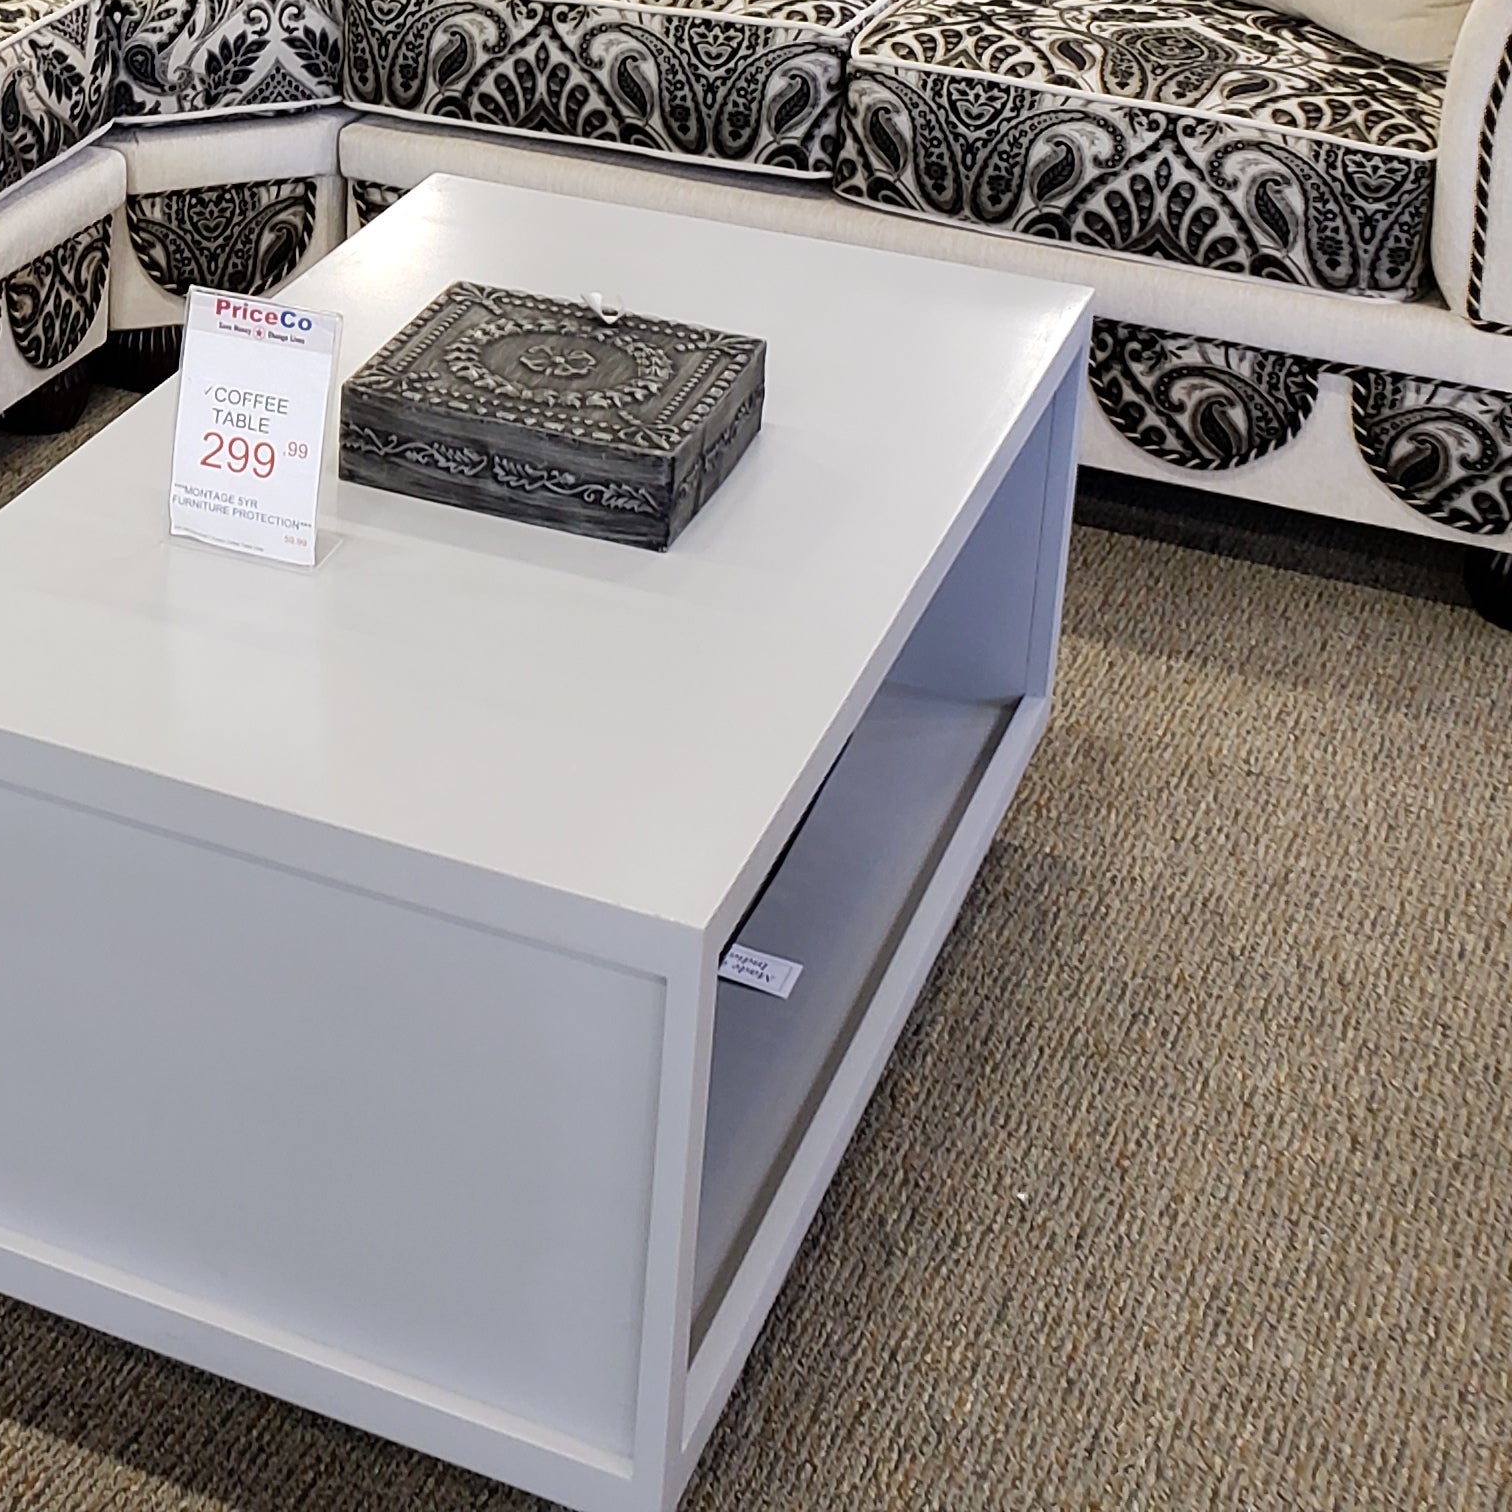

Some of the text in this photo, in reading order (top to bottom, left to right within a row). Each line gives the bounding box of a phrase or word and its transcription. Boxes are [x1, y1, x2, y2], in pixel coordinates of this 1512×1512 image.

[216, 298, 313, 331] PriceCo
[214, 387, 289, 415] COFFEE
[212, 408, 270, 434] TABLE
[200, 432, 275, 478] 299
[172, 494, 229, 516] FURNITURE
[237, 496, 258, 509] 5YR
